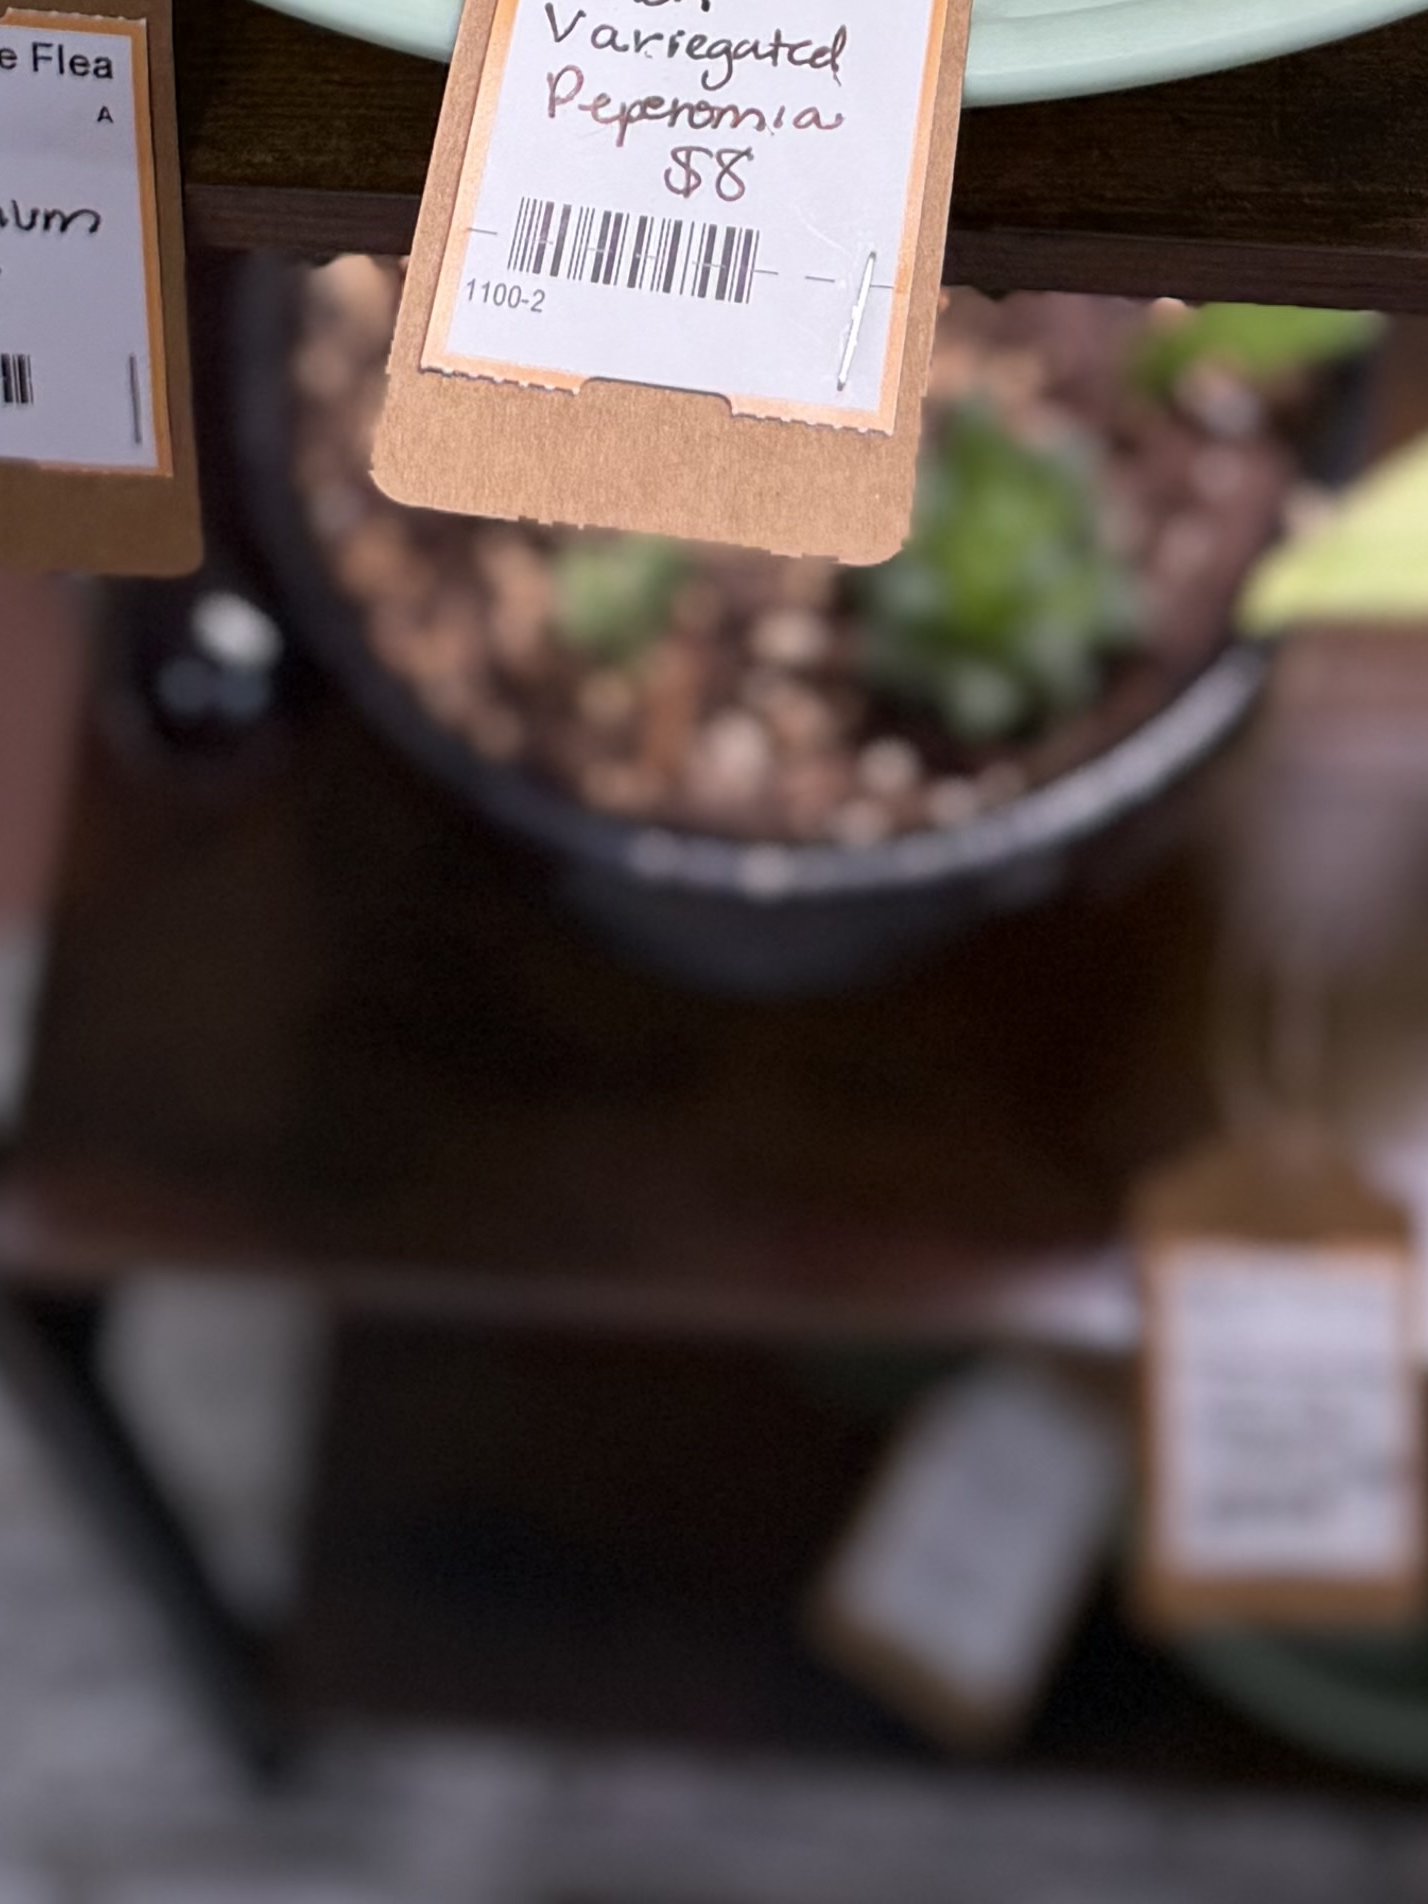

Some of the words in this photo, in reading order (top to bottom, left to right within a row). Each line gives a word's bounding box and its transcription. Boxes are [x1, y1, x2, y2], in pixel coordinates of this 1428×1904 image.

[32, 41, 114, 80] Flea
[544, 2, 848, 91] Variegated
[96, 105, 115, 124] A
[546, 64, 847, 148] Peperomia
[663, 145, 755, 202] $8
[467, 278, 546, 313] 1100-2
